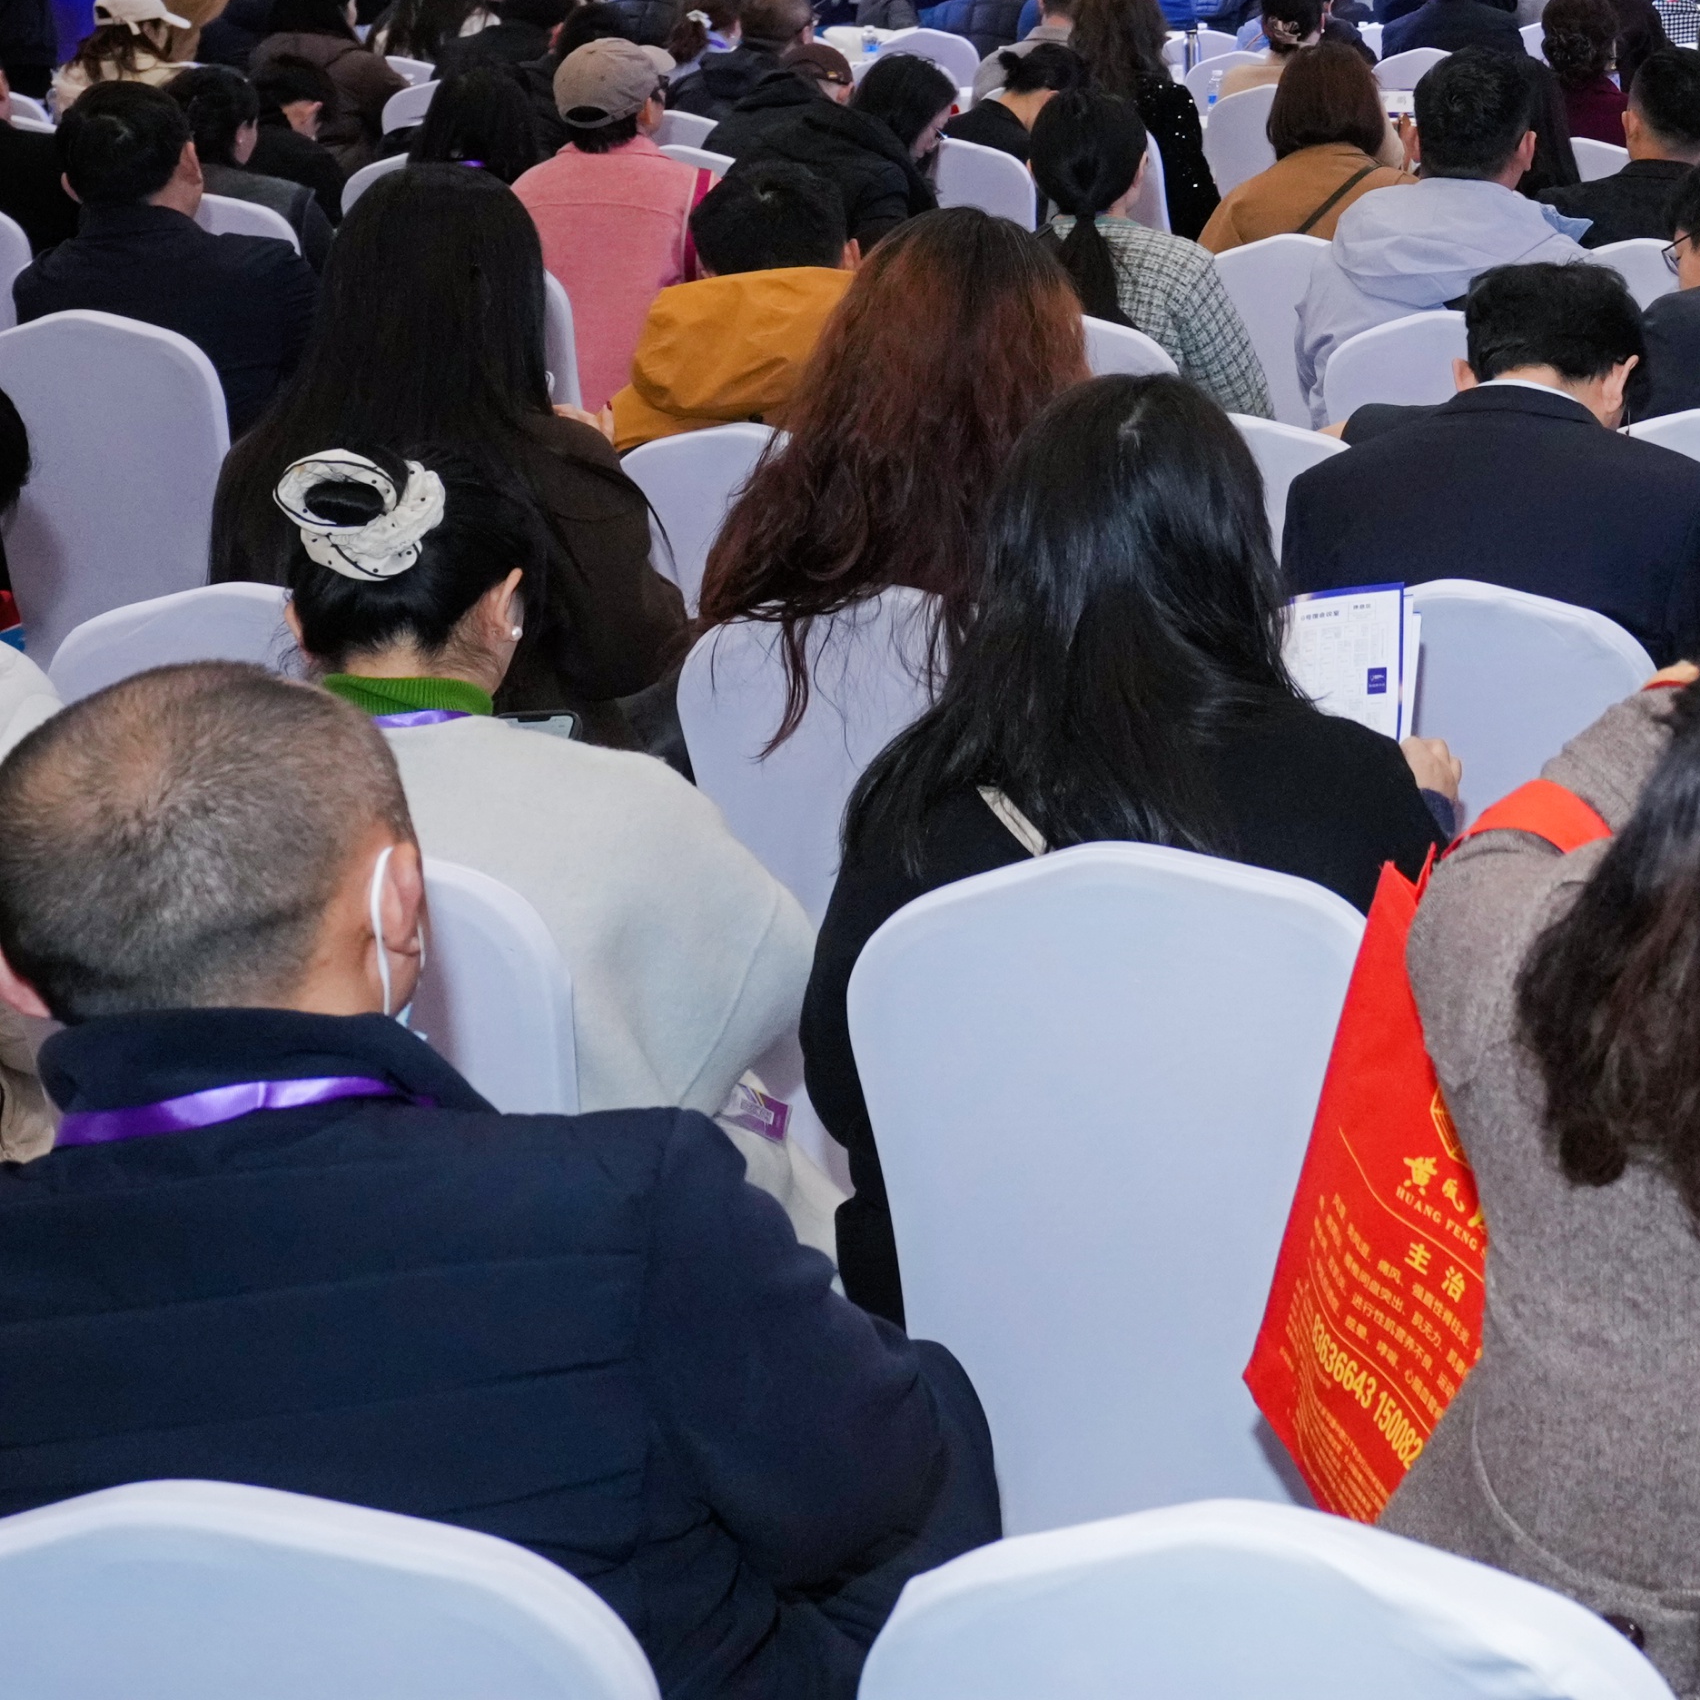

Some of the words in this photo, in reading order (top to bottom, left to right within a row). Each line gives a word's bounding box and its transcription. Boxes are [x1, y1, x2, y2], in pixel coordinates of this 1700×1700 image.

[1396, 1185, 1442, 1224] HUANG
[1445, 1218, 1478, 1251] FENG
[1404, 1242, 1466, 1303] 主治
